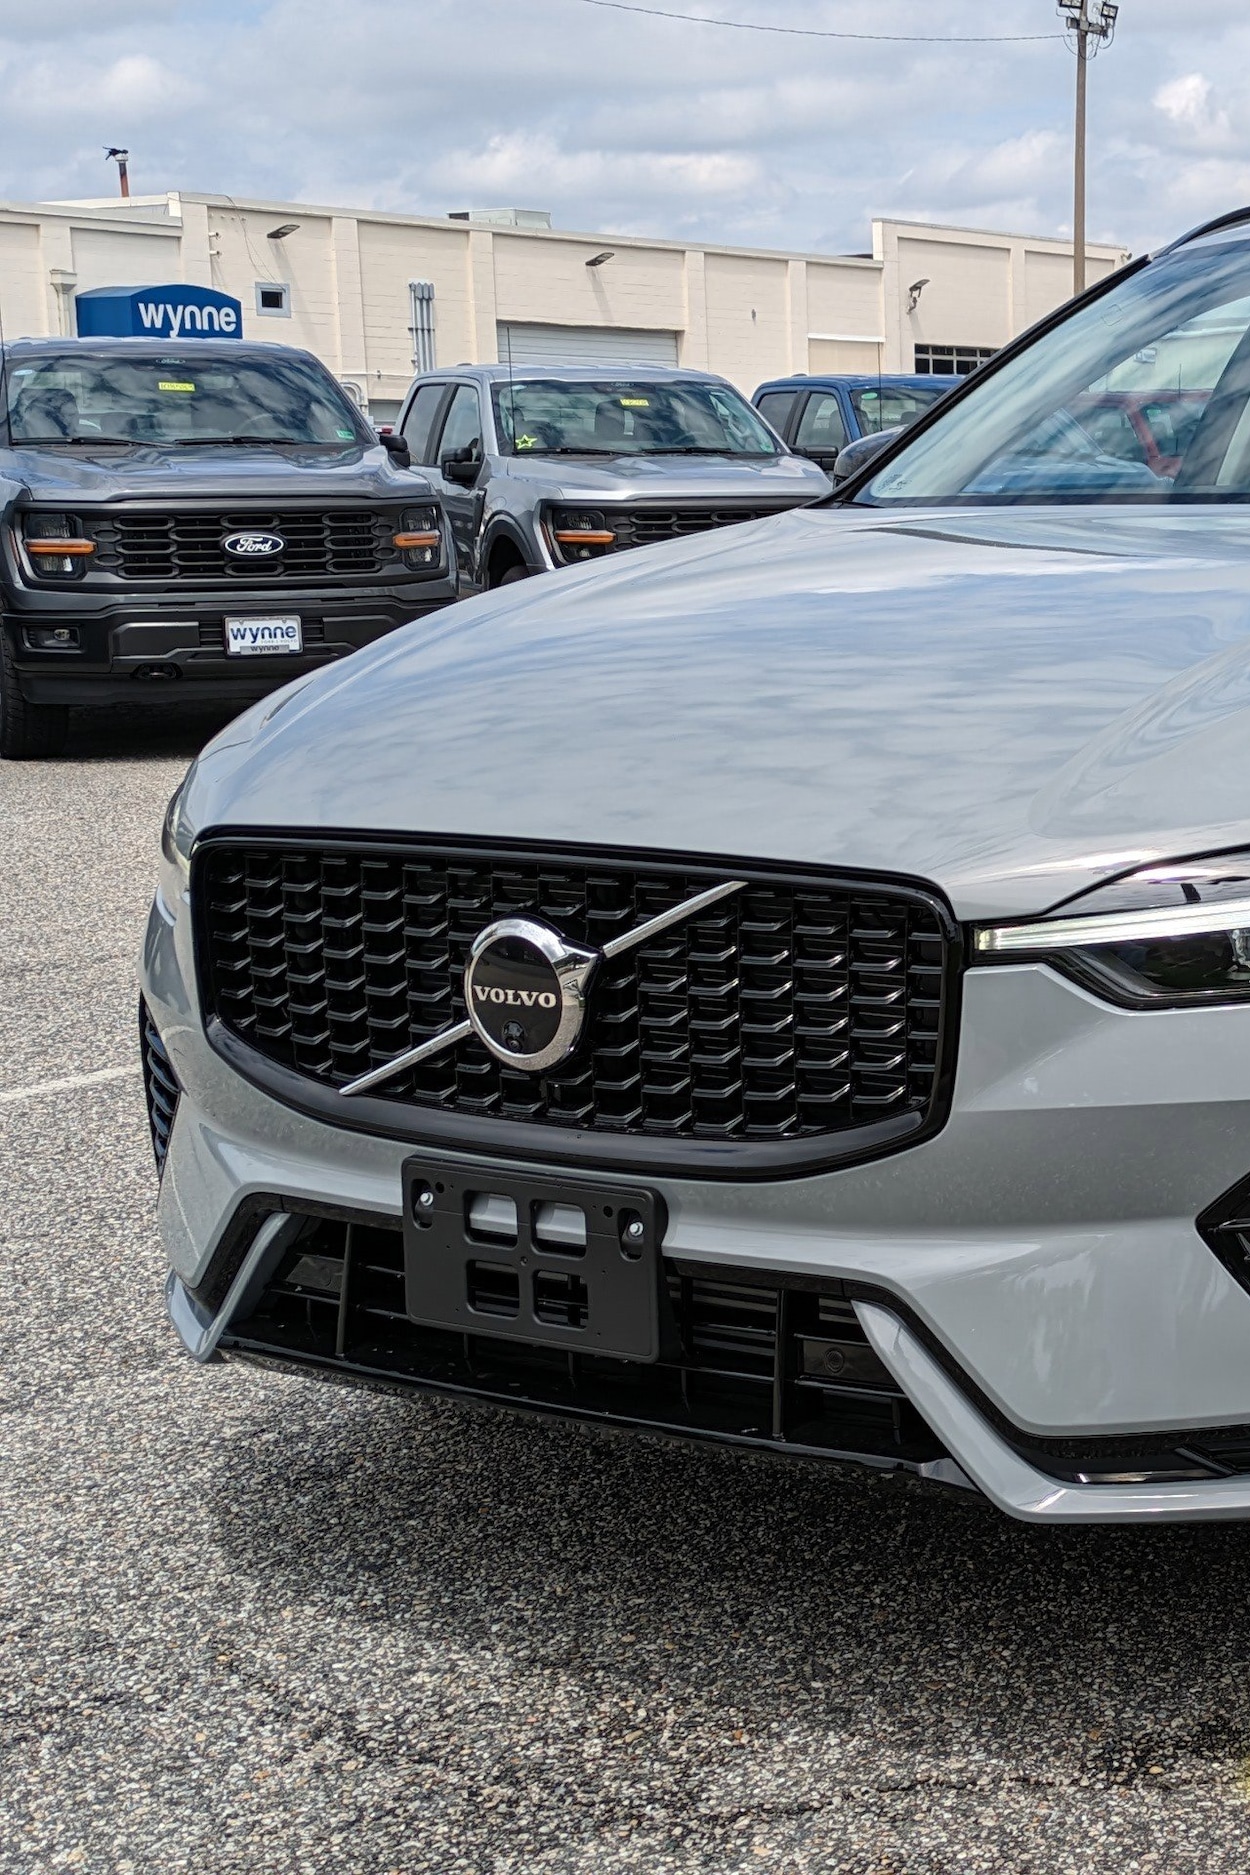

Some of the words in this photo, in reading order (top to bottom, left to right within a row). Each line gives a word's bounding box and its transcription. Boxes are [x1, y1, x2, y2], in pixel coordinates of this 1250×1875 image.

[137, 302, 237, 338] wynne
[230, 626, 297, 644] wynne
[473, 984, 557, 1009] VOLVO
